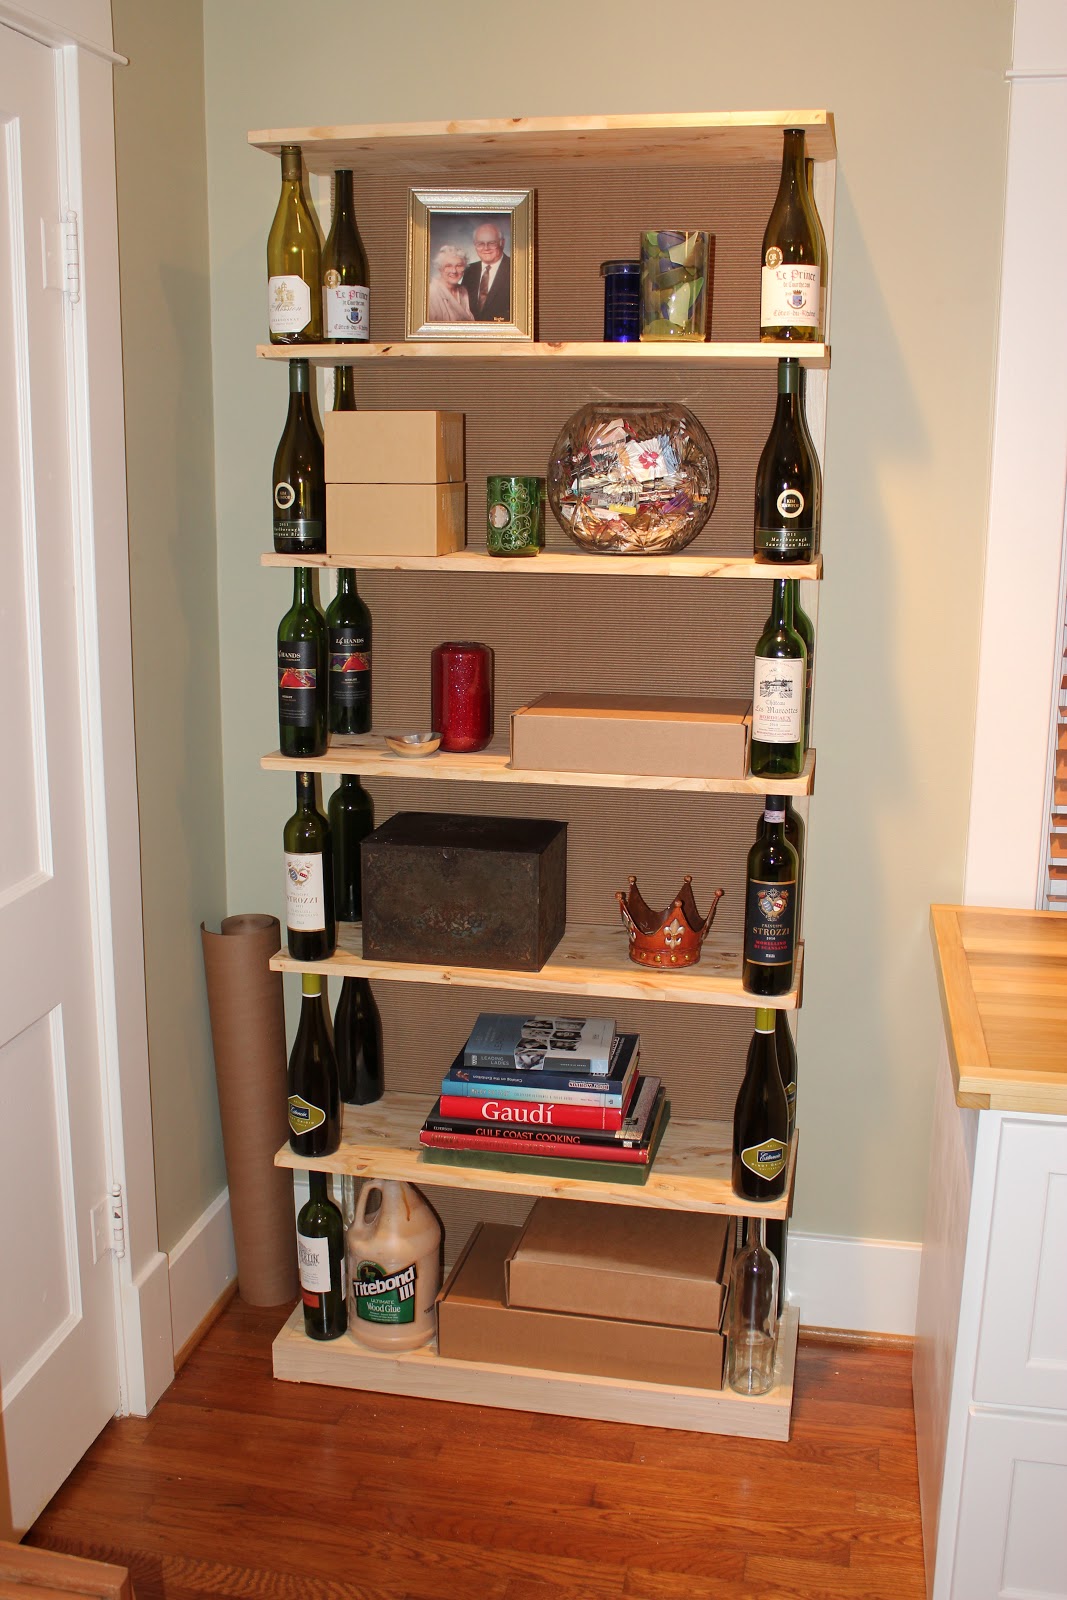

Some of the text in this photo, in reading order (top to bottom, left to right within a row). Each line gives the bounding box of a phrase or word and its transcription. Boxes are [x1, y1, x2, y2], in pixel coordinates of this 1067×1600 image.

[775, 269, 816, 282] Le Prince
[335, 290, 346, 299] Le
[286, 895, 319, 904] STROZZI
[752, 926, 790, 937] STROZZI
[481, 1101, 554, 1125] Gaudí
[475, 1127, 581, 1144] GULF COAST COOKING
[353, 1266, 415, 1297] Titebond
[398, 1281, 415, 1302] III
[366, 1301, 401, 1313] Wood Glue
